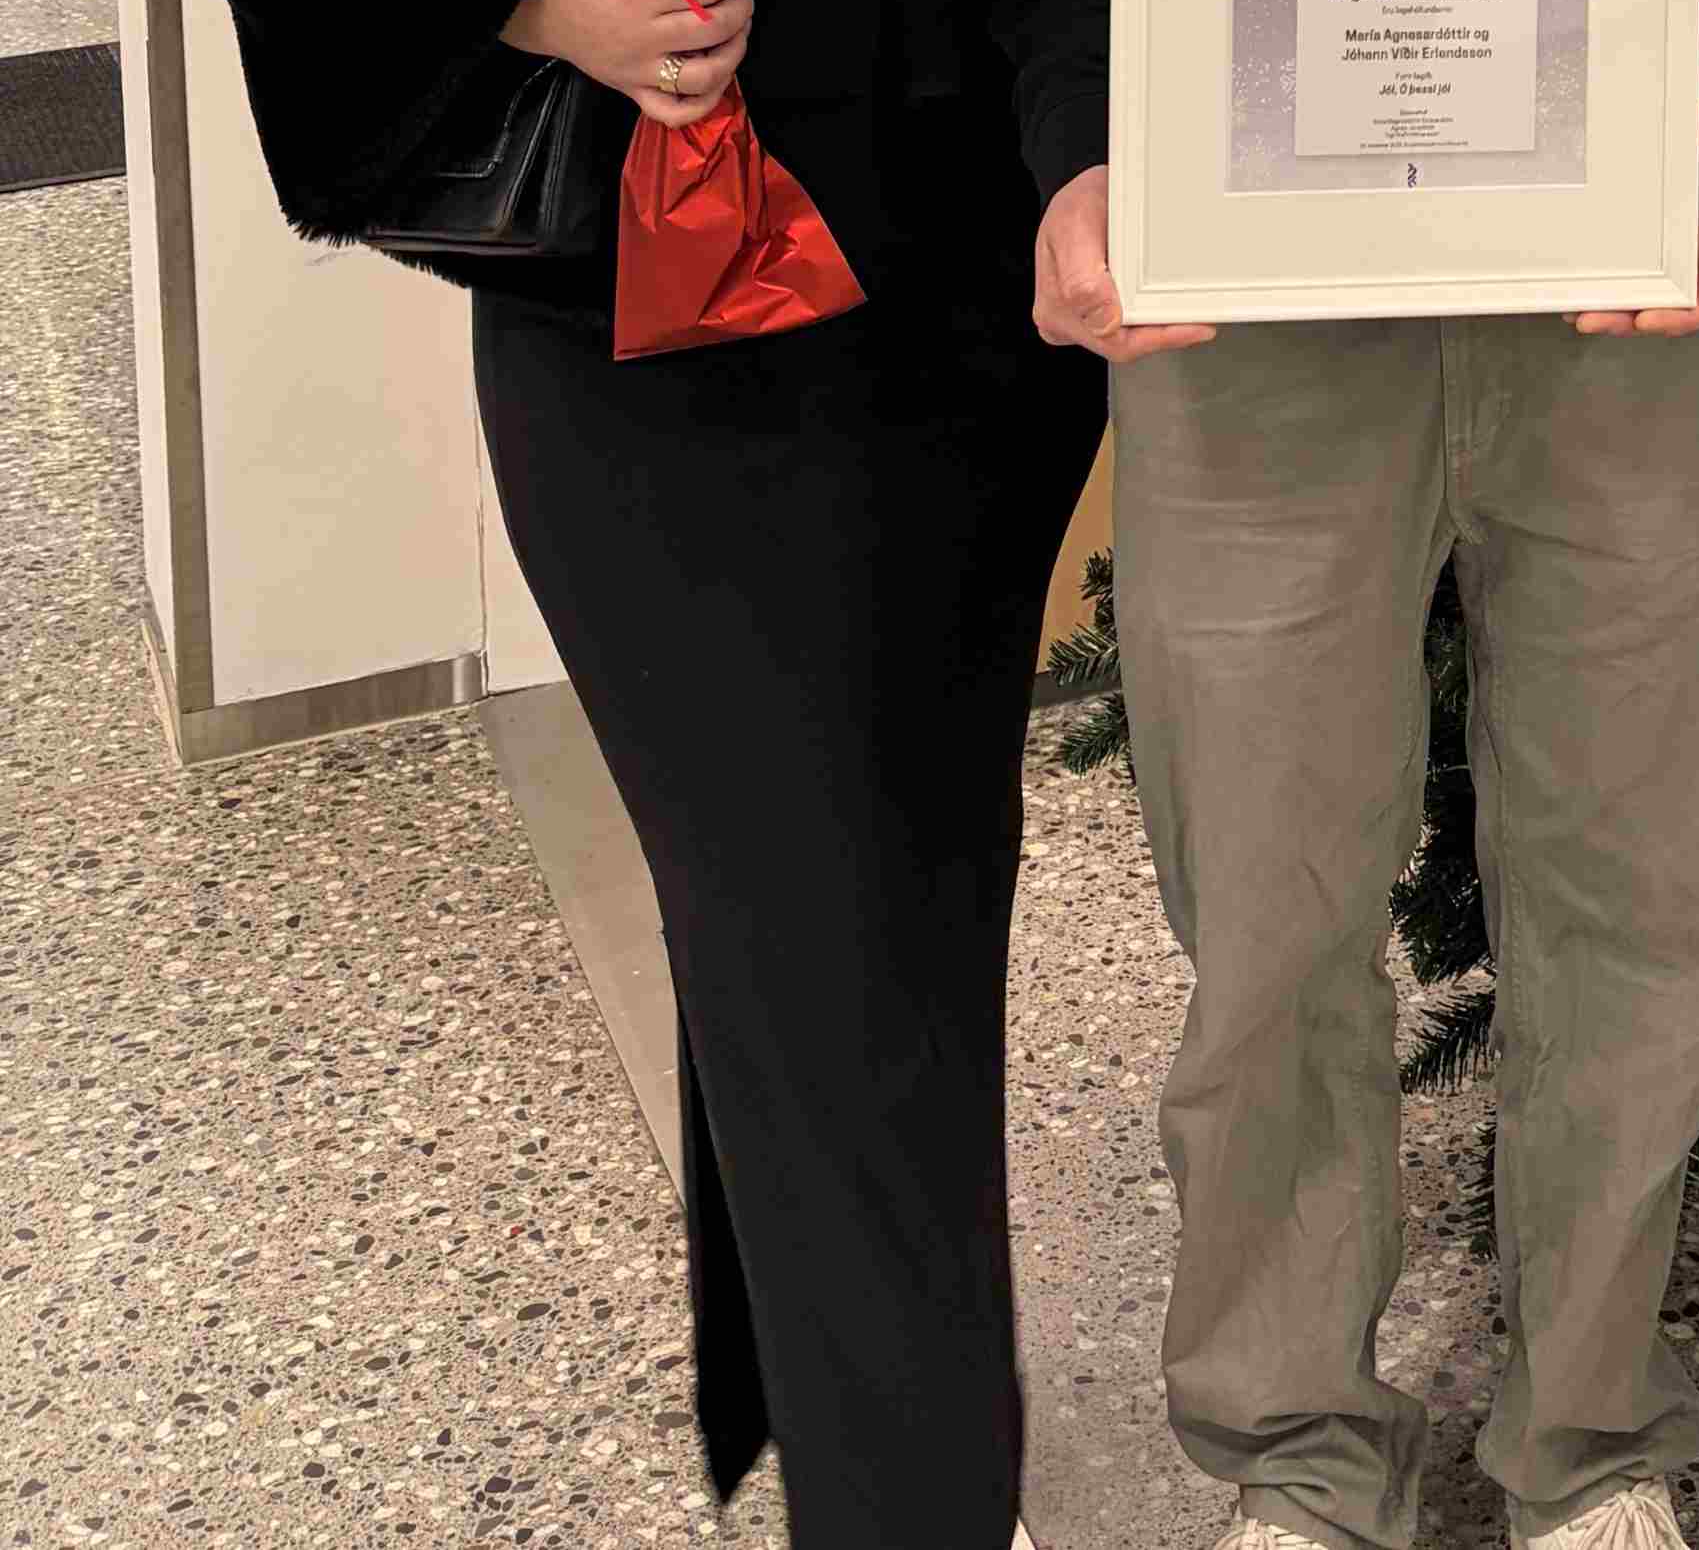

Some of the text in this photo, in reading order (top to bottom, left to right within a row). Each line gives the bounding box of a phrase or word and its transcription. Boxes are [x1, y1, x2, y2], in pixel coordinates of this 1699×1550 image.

[1345, 27, 1490, 44] María Agnesardóttir og
[1341, 47, 1389, 61] Jóhann
[1422, 46, 1493, 60] Erlendsson
